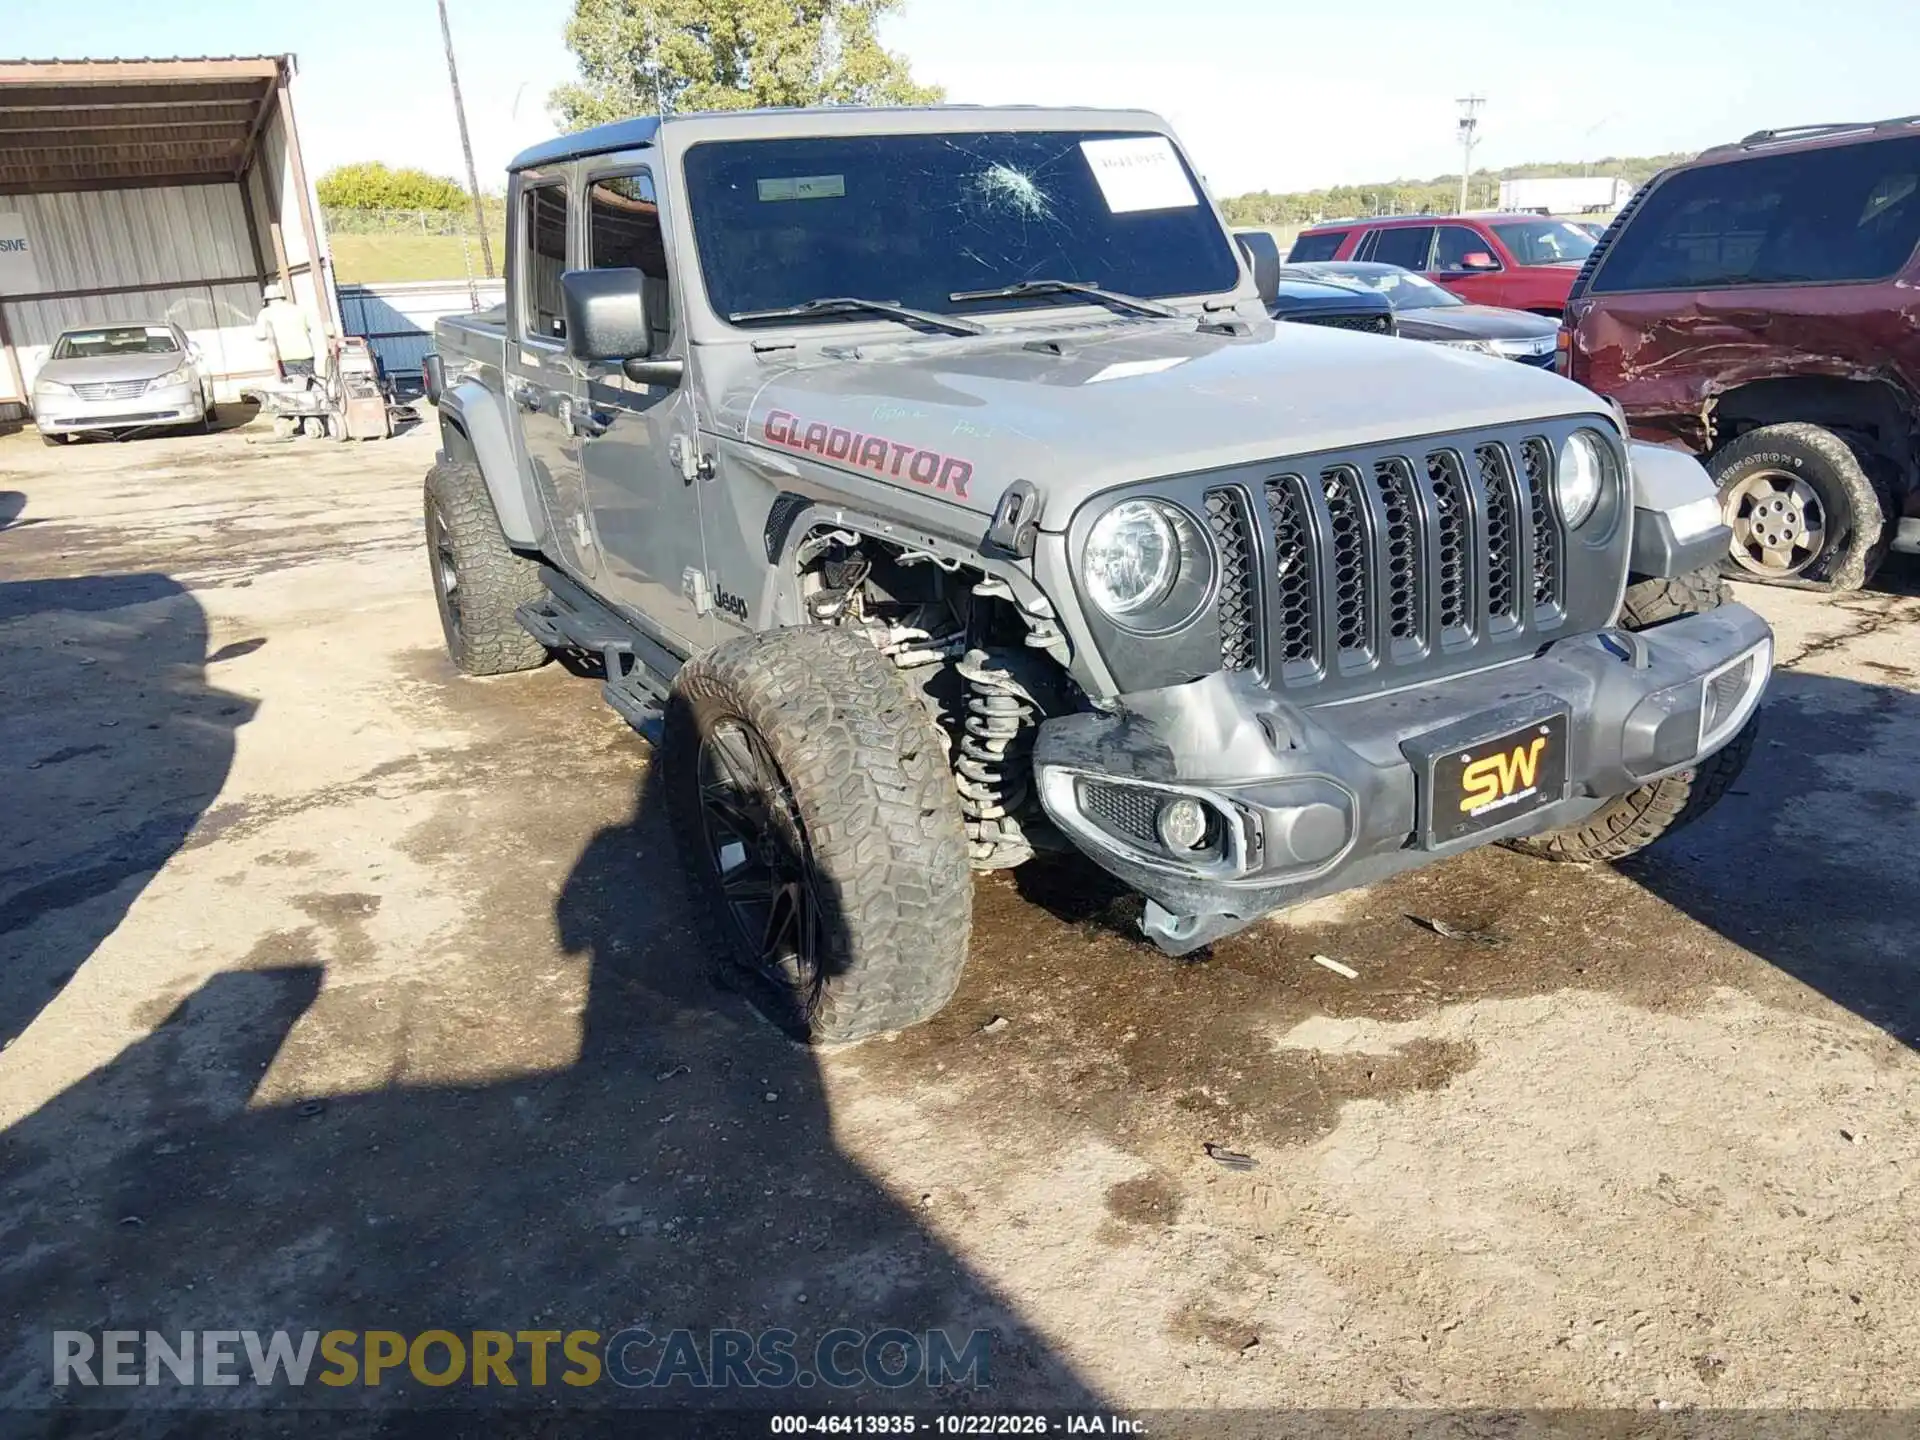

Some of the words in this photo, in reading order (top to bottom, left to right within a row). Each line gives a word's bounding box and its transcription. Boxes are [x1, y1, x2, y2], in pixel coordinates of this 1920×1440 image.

[764, 408, 973, 500] GLADIATOR
[714, 584, 748, 622] Jeep
[1460, 737, 1546, 811] SW
